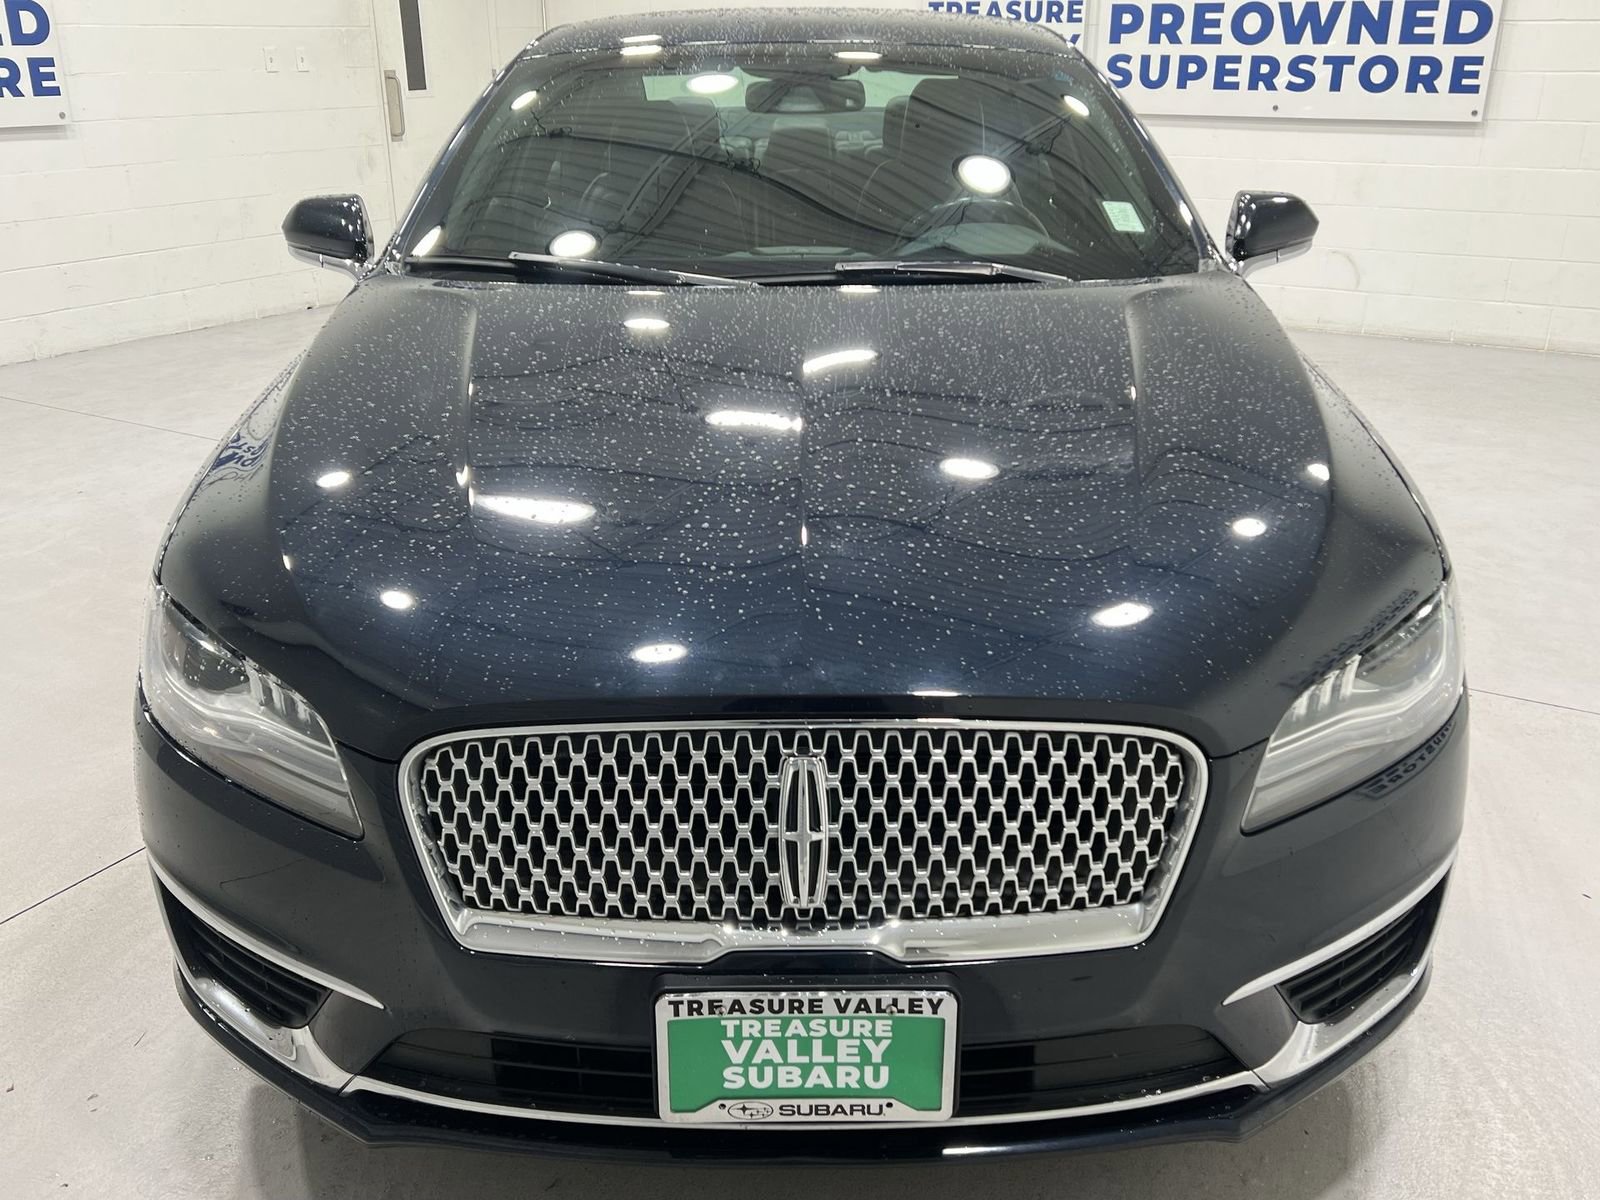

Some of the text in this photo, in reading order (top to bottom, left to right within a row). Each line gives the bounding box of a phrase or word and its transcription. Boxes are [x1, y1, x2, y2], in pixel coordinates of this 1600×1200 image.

[1109, 0, 1494, 46] PREOWNED
[1107, 53, 1485, 94] SUPERSTORE
[668, 998, 944, 1017] TREASURE VALLEY
[720, 1018, 893, 1038] TREASURE
[721, 1038, 892, 1065] VALLEY
[722, 1065, 890, 1090] SUBARU
[778, 1103, 884, 1117] SUBARU
